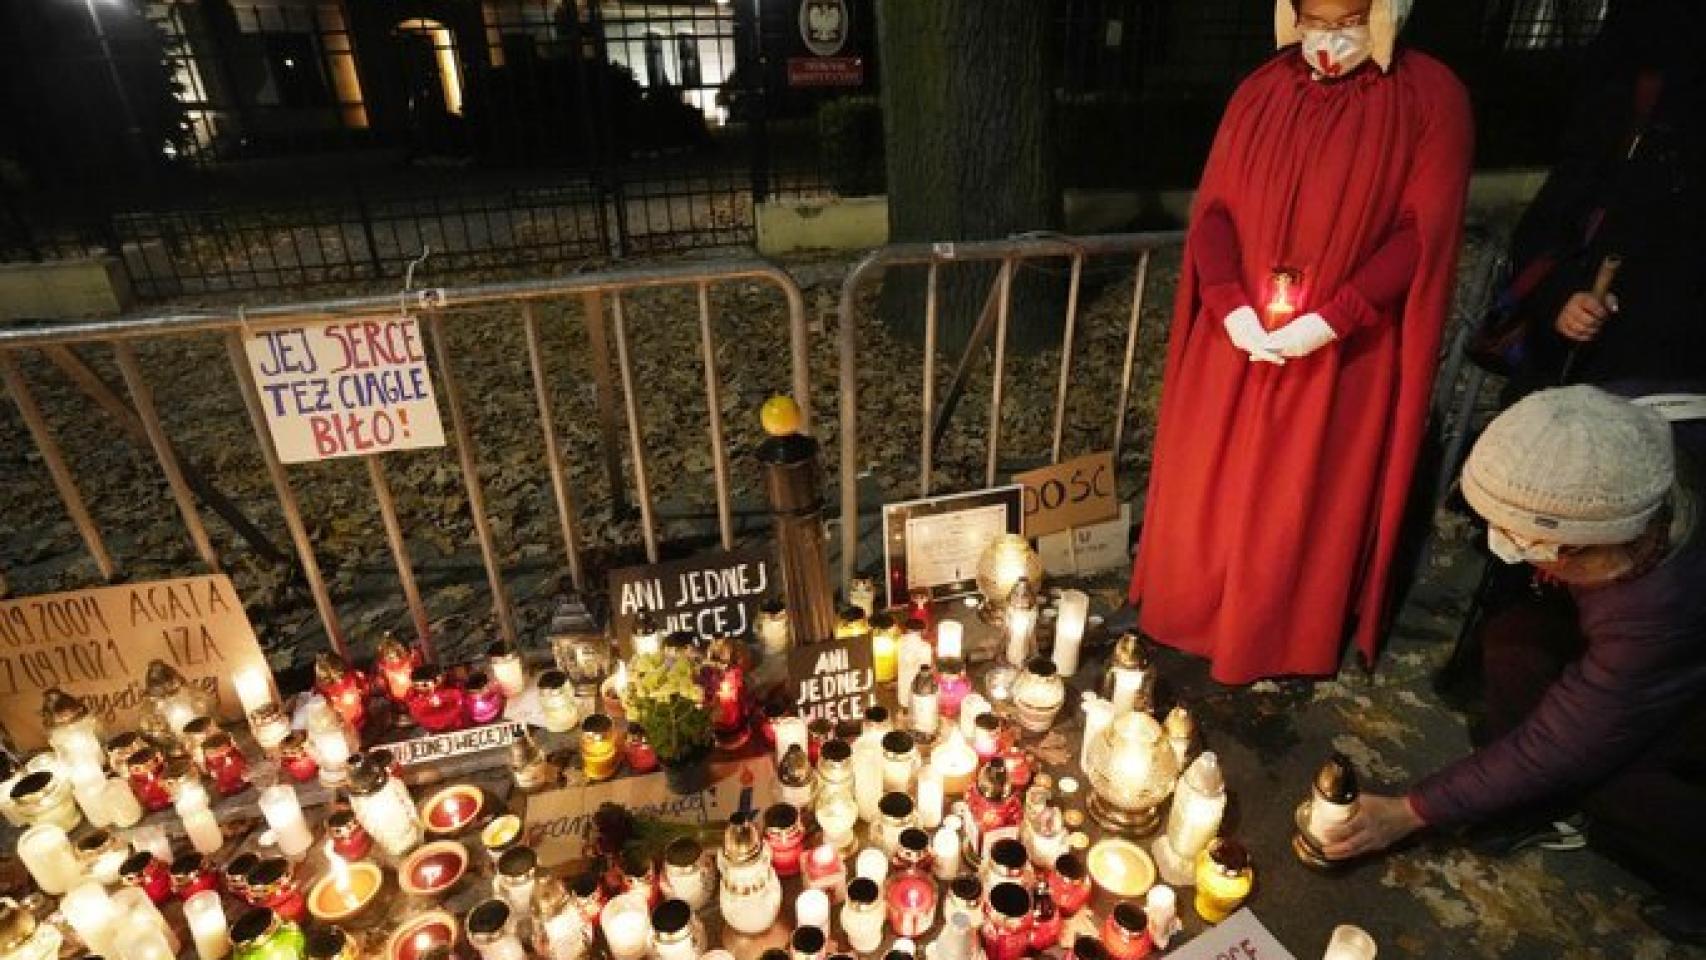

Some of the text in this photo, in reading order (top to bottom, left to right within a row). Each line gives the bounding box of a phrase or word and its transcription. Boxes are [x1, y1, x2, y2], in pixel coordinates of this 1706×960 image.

[255, 320, 425, 376] JEJ SERCE
[130, 578, 231, 627] AGATA
[620, 561, 768, 615] ANI JEDNEJ
[163, 623, 225, 666] IZA
[813, 648, 849, 674] ANI
[795, 668, 873, 705] JEDNEJ
